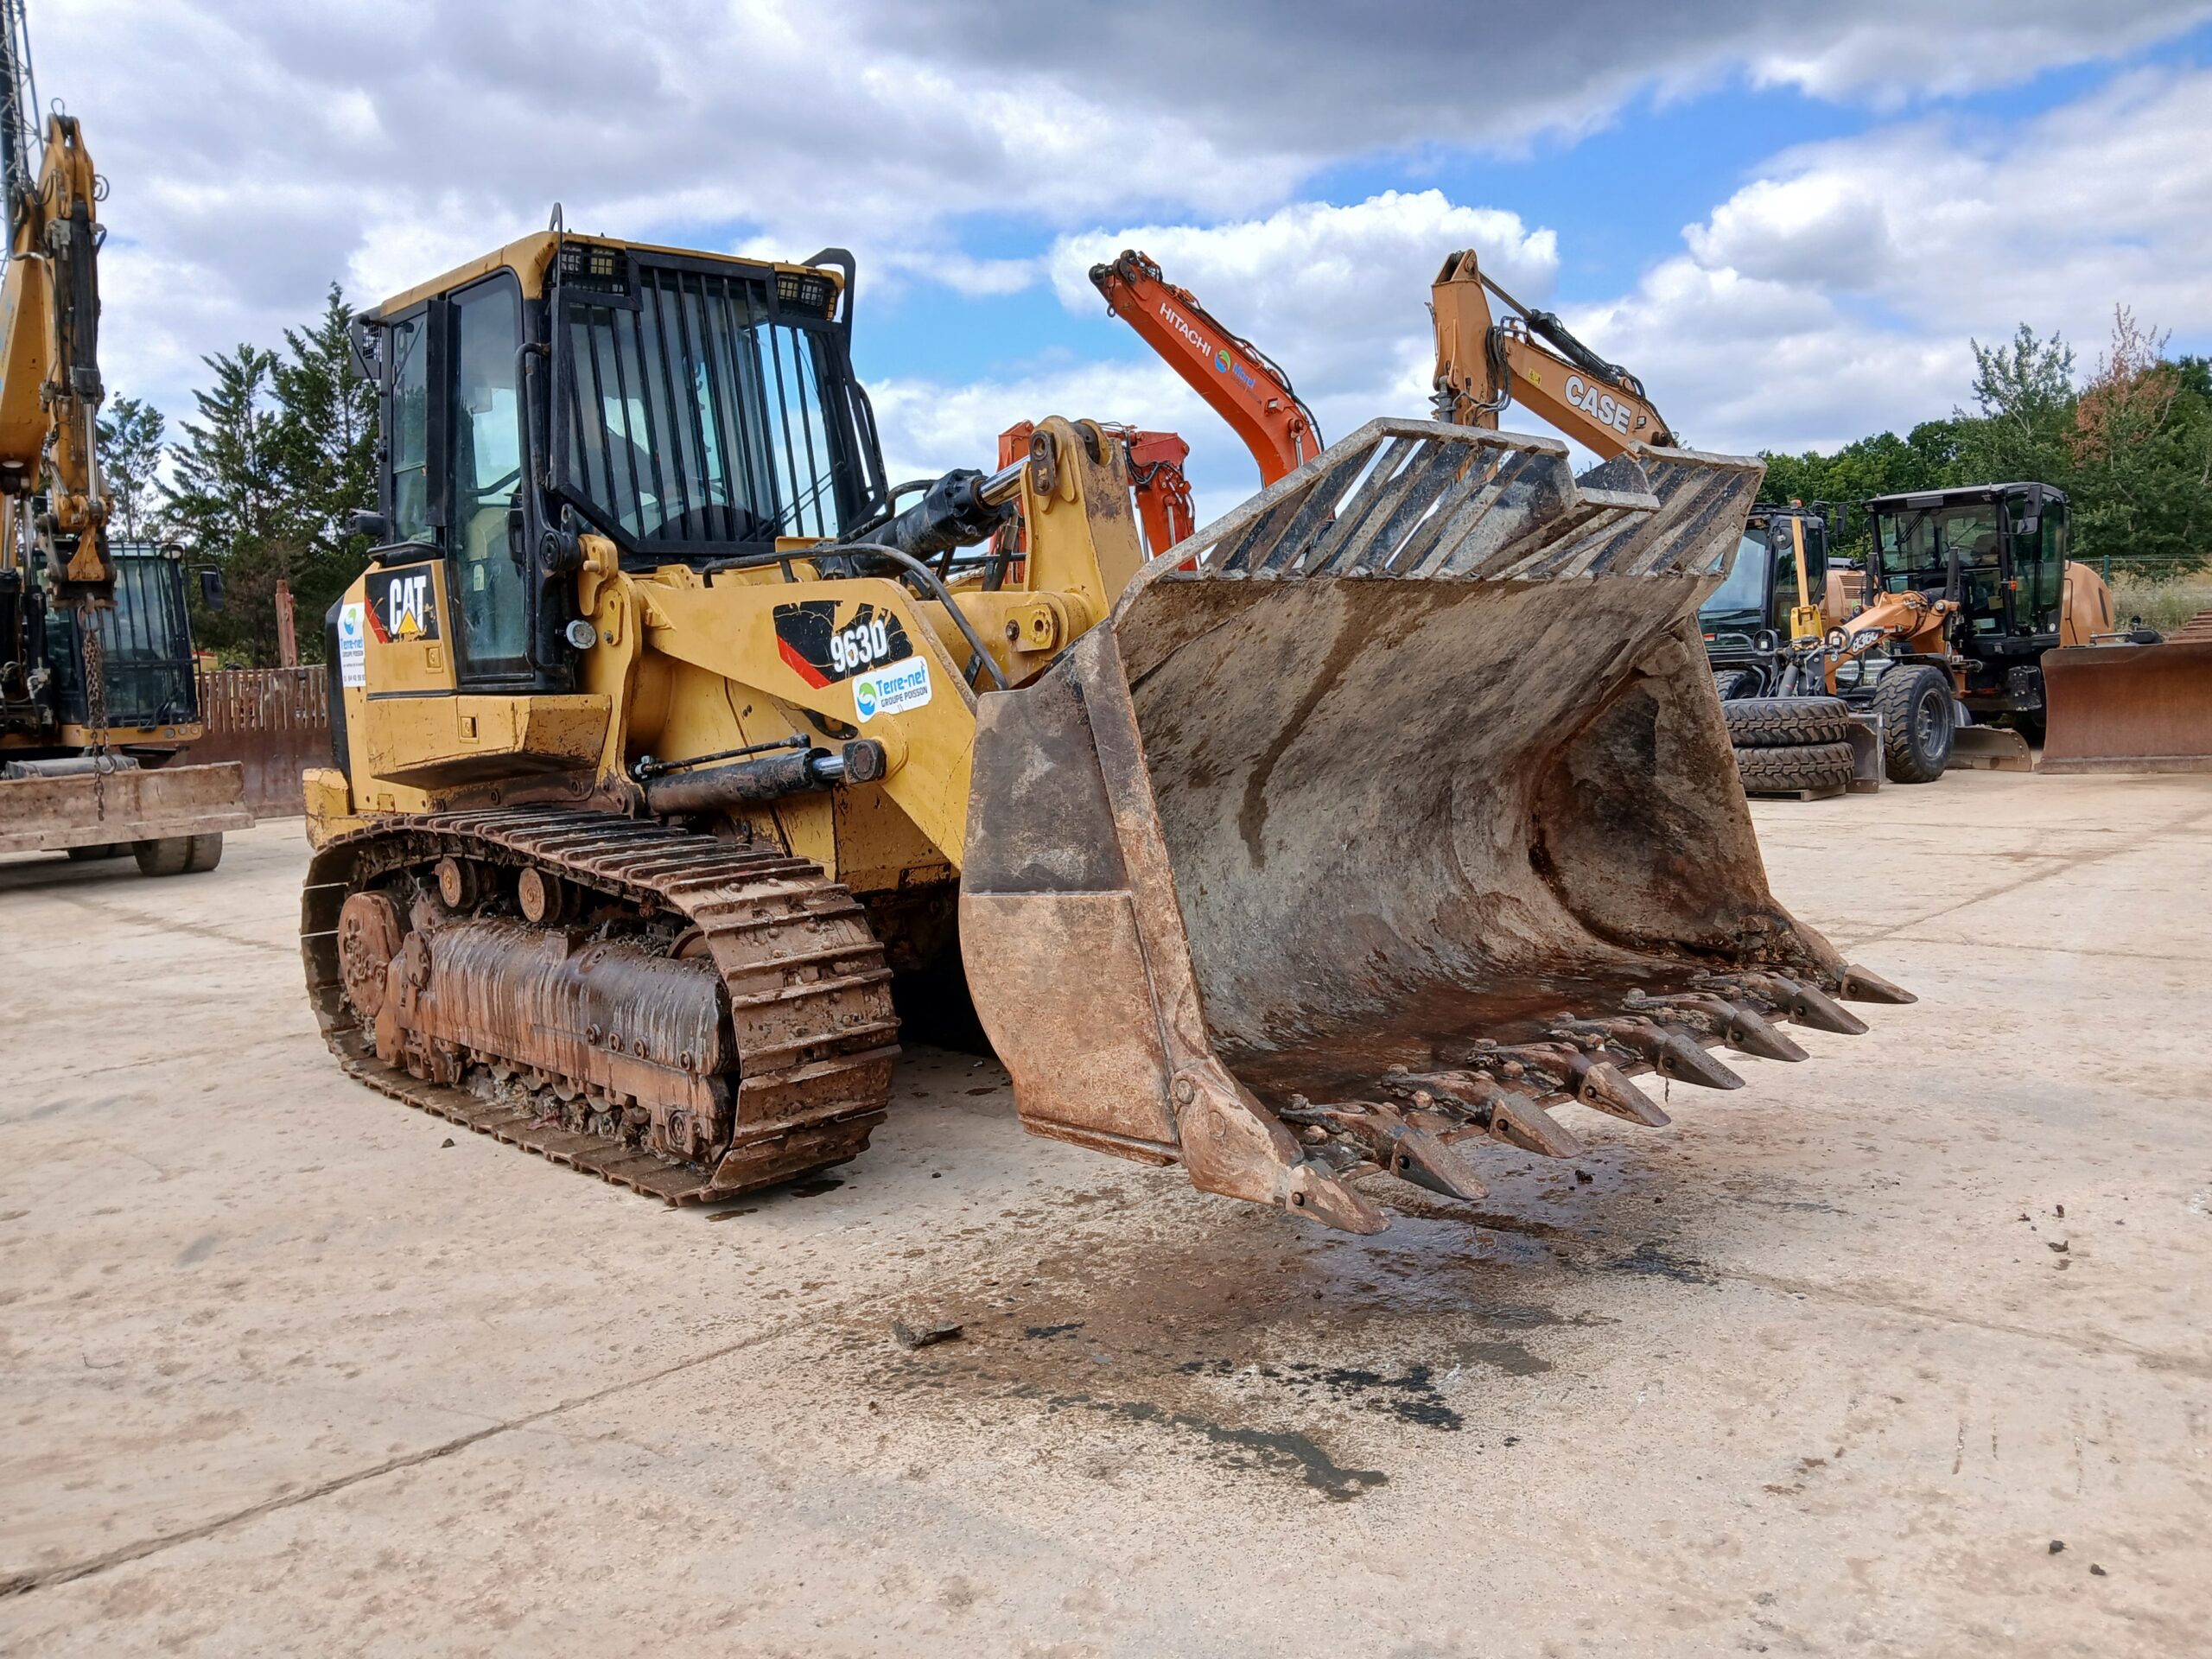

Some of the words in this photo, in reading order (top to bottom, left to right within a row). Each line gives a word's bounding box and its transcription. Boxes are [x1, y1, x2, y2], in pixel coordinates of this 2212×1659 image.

[1160, 302, 1211, 357] HITACHI
[1565, 374, 1631, 435] CASE
[390, 575, 426, 635] CAT
[830, 620, 887, 672] 963D
[876, 665, 925, 696] Terre-net
[881, 693, 904, 707] GROUPE
[904, 686, 928, 700] POISSON
